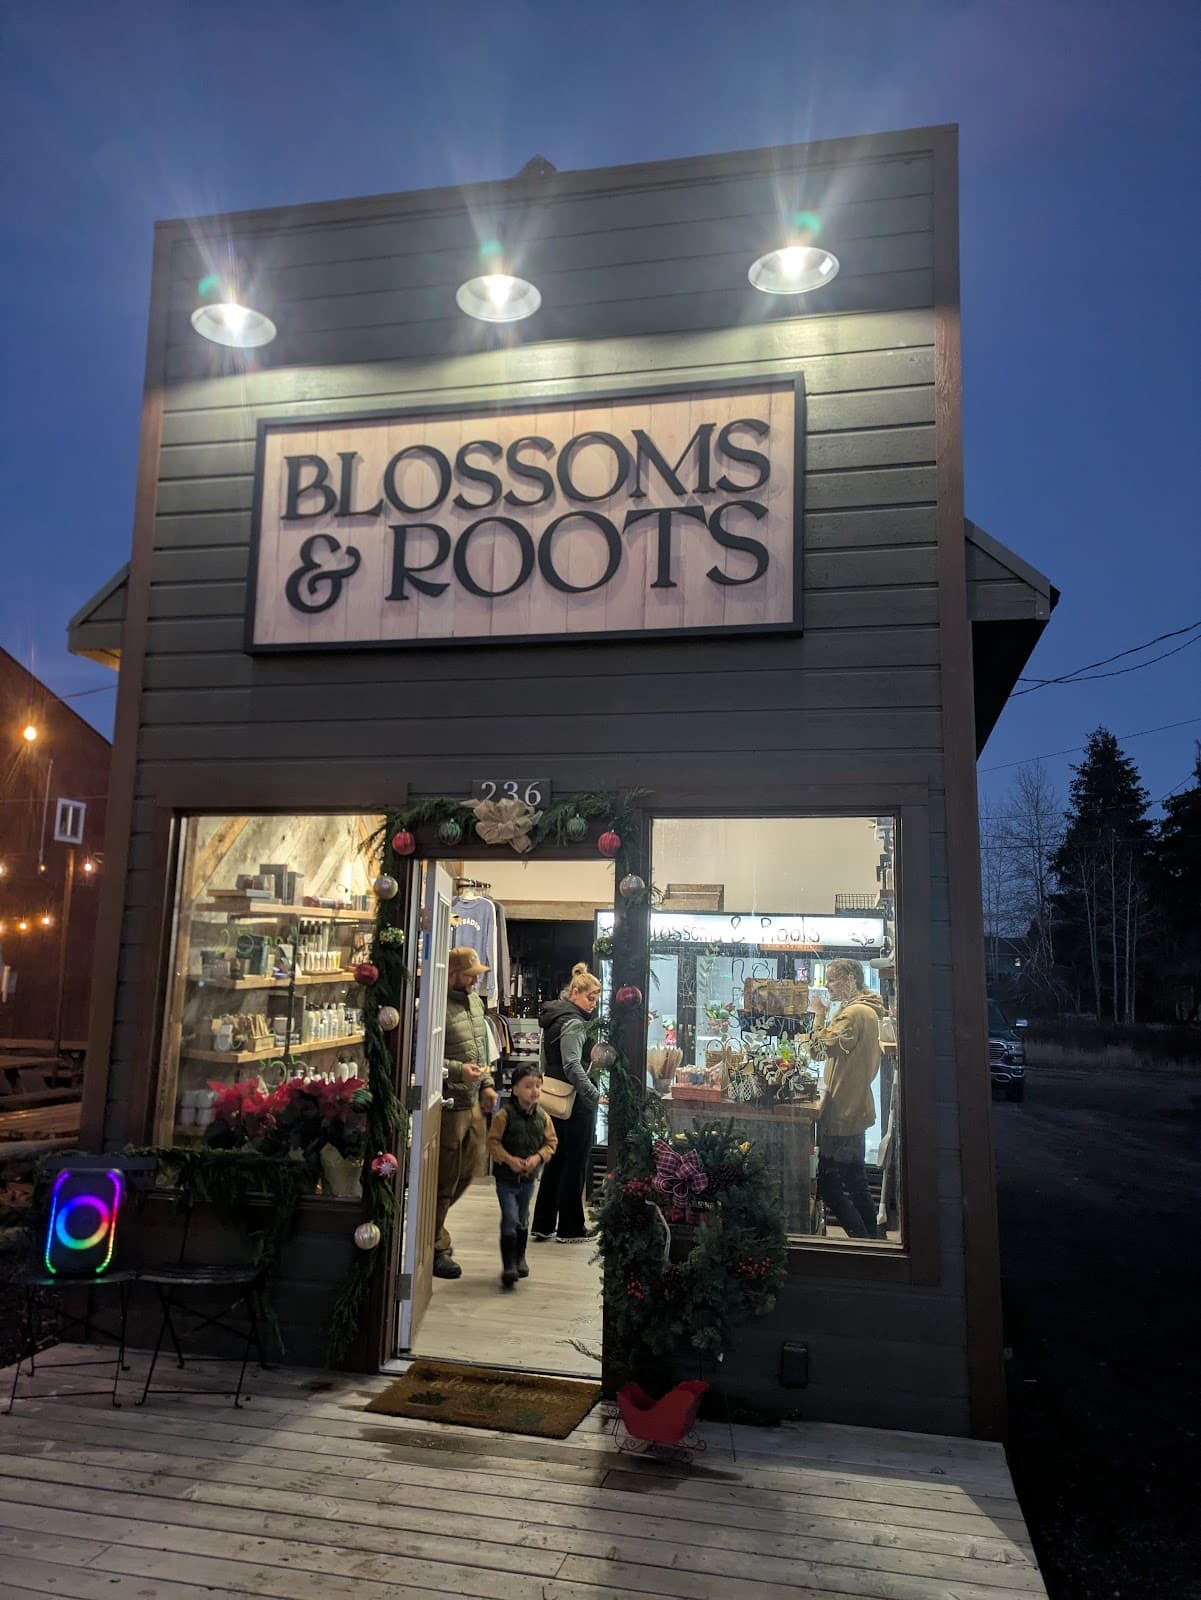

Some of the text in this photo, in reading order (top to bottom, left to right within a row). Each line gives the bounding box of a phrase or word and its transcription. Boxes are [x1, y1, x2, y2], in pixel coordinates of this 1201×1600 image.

[281, 419, 771, 520] BLOSSOMS
[285, 499, 770, 614] & ROOTS
[481, 781, 541, 806] 236
